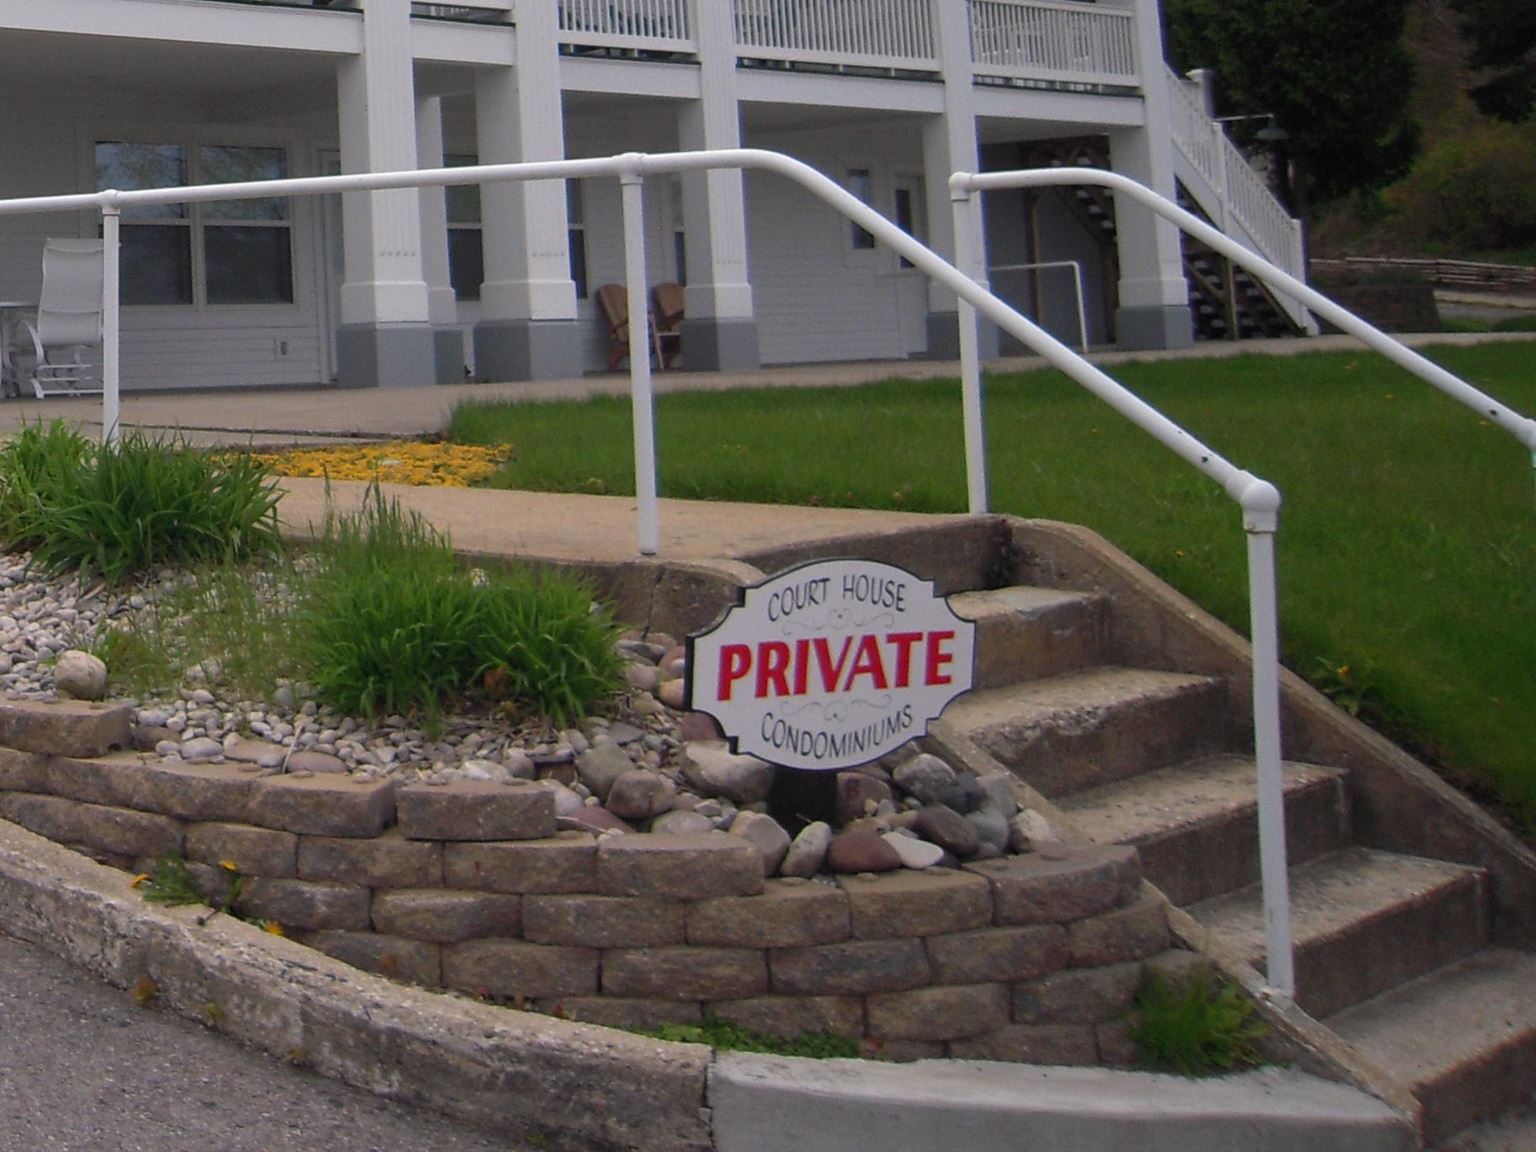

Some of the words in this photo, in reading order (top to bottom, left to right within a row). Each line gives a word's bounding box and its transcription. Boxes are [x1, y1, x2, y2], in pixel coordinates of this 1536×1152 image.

[768, 577, 831, 622] COURT
[842, 574, 906, 613] HOUSE
[716, 630, 955, 702] PRIVATE
[761, 704, 913, 759] CONDOMINIUMS
